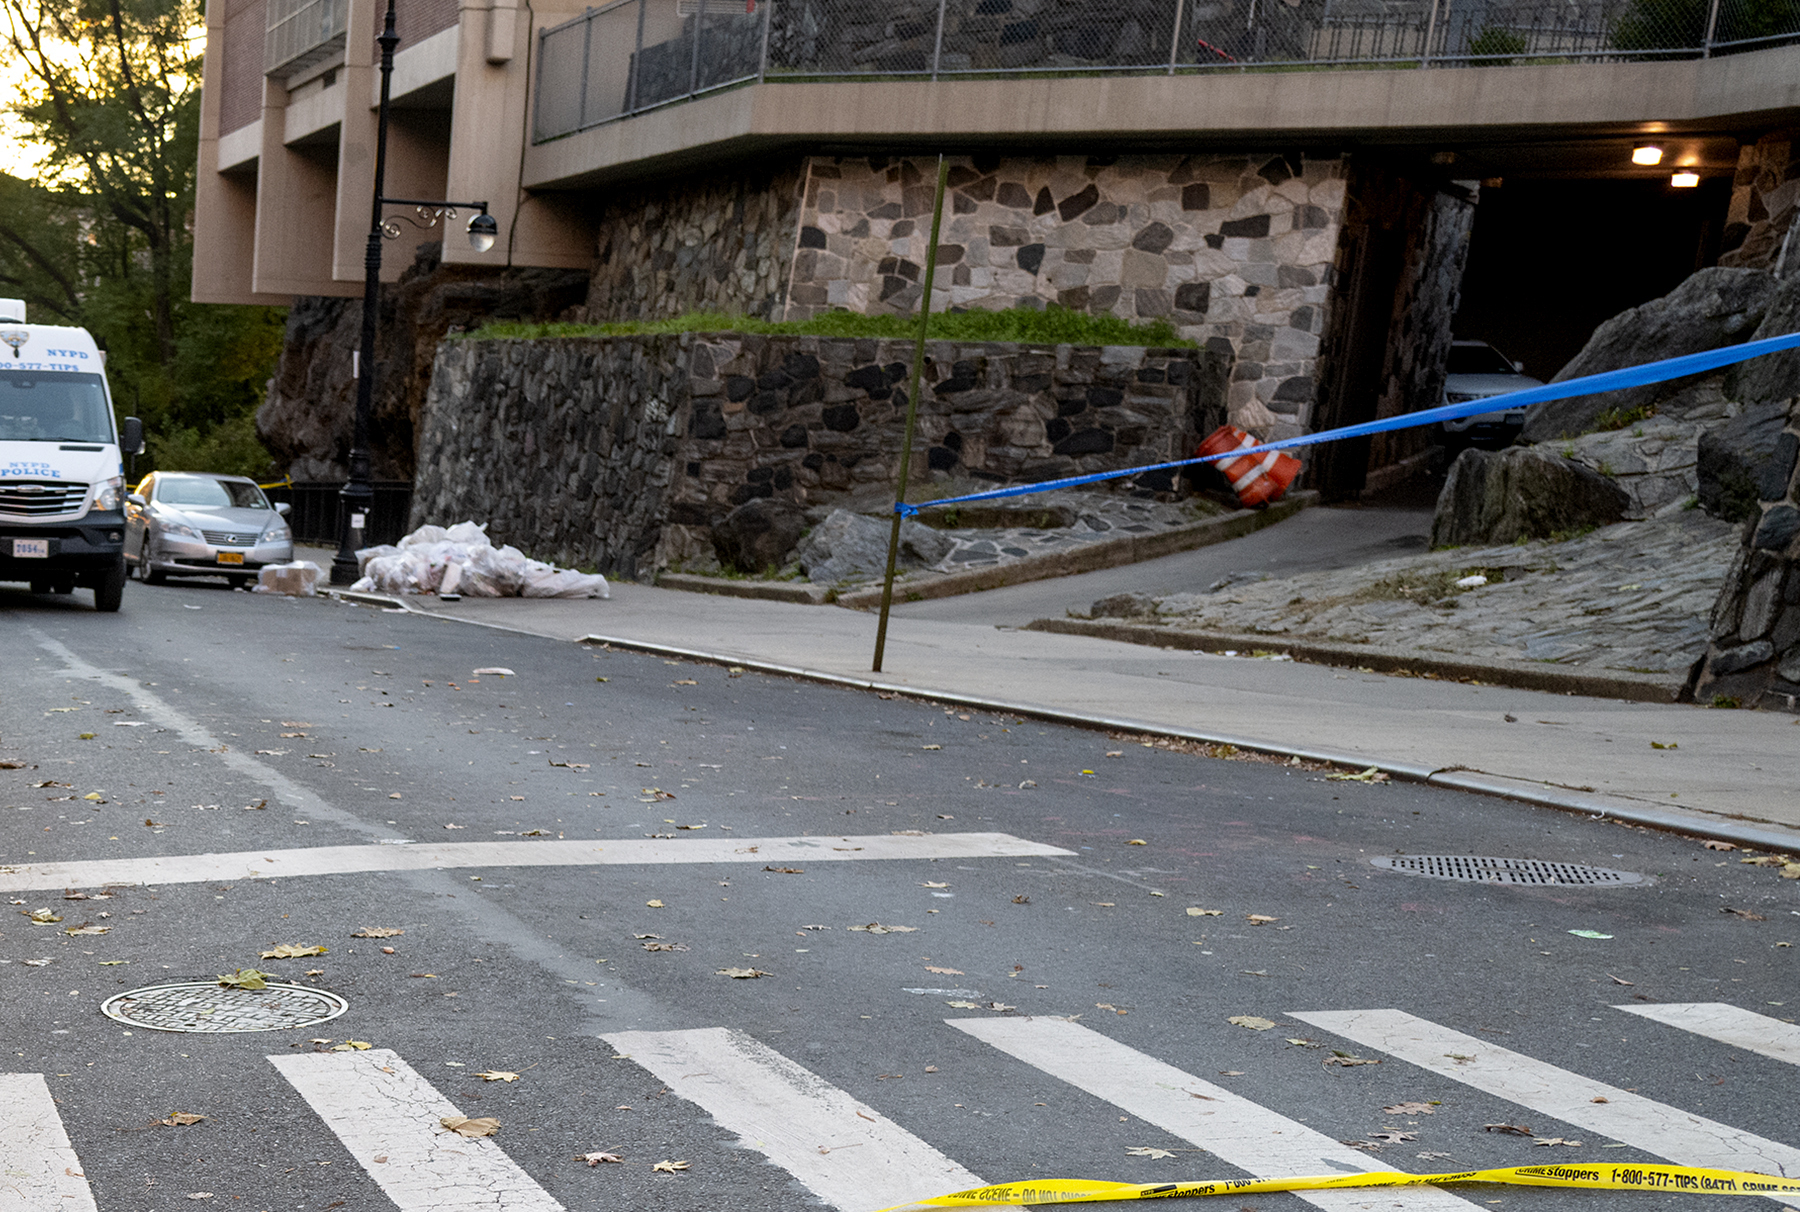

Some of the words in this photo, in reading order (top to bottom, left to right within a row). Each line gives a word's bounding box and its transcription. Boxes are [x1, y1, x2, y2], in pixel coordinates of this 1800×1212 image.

[47, 349, 89, 359] NYPD
[1, 468, 60, 478] POLICE
[1611, 1168, 1699, 1190] 1-800-577-TIPS
